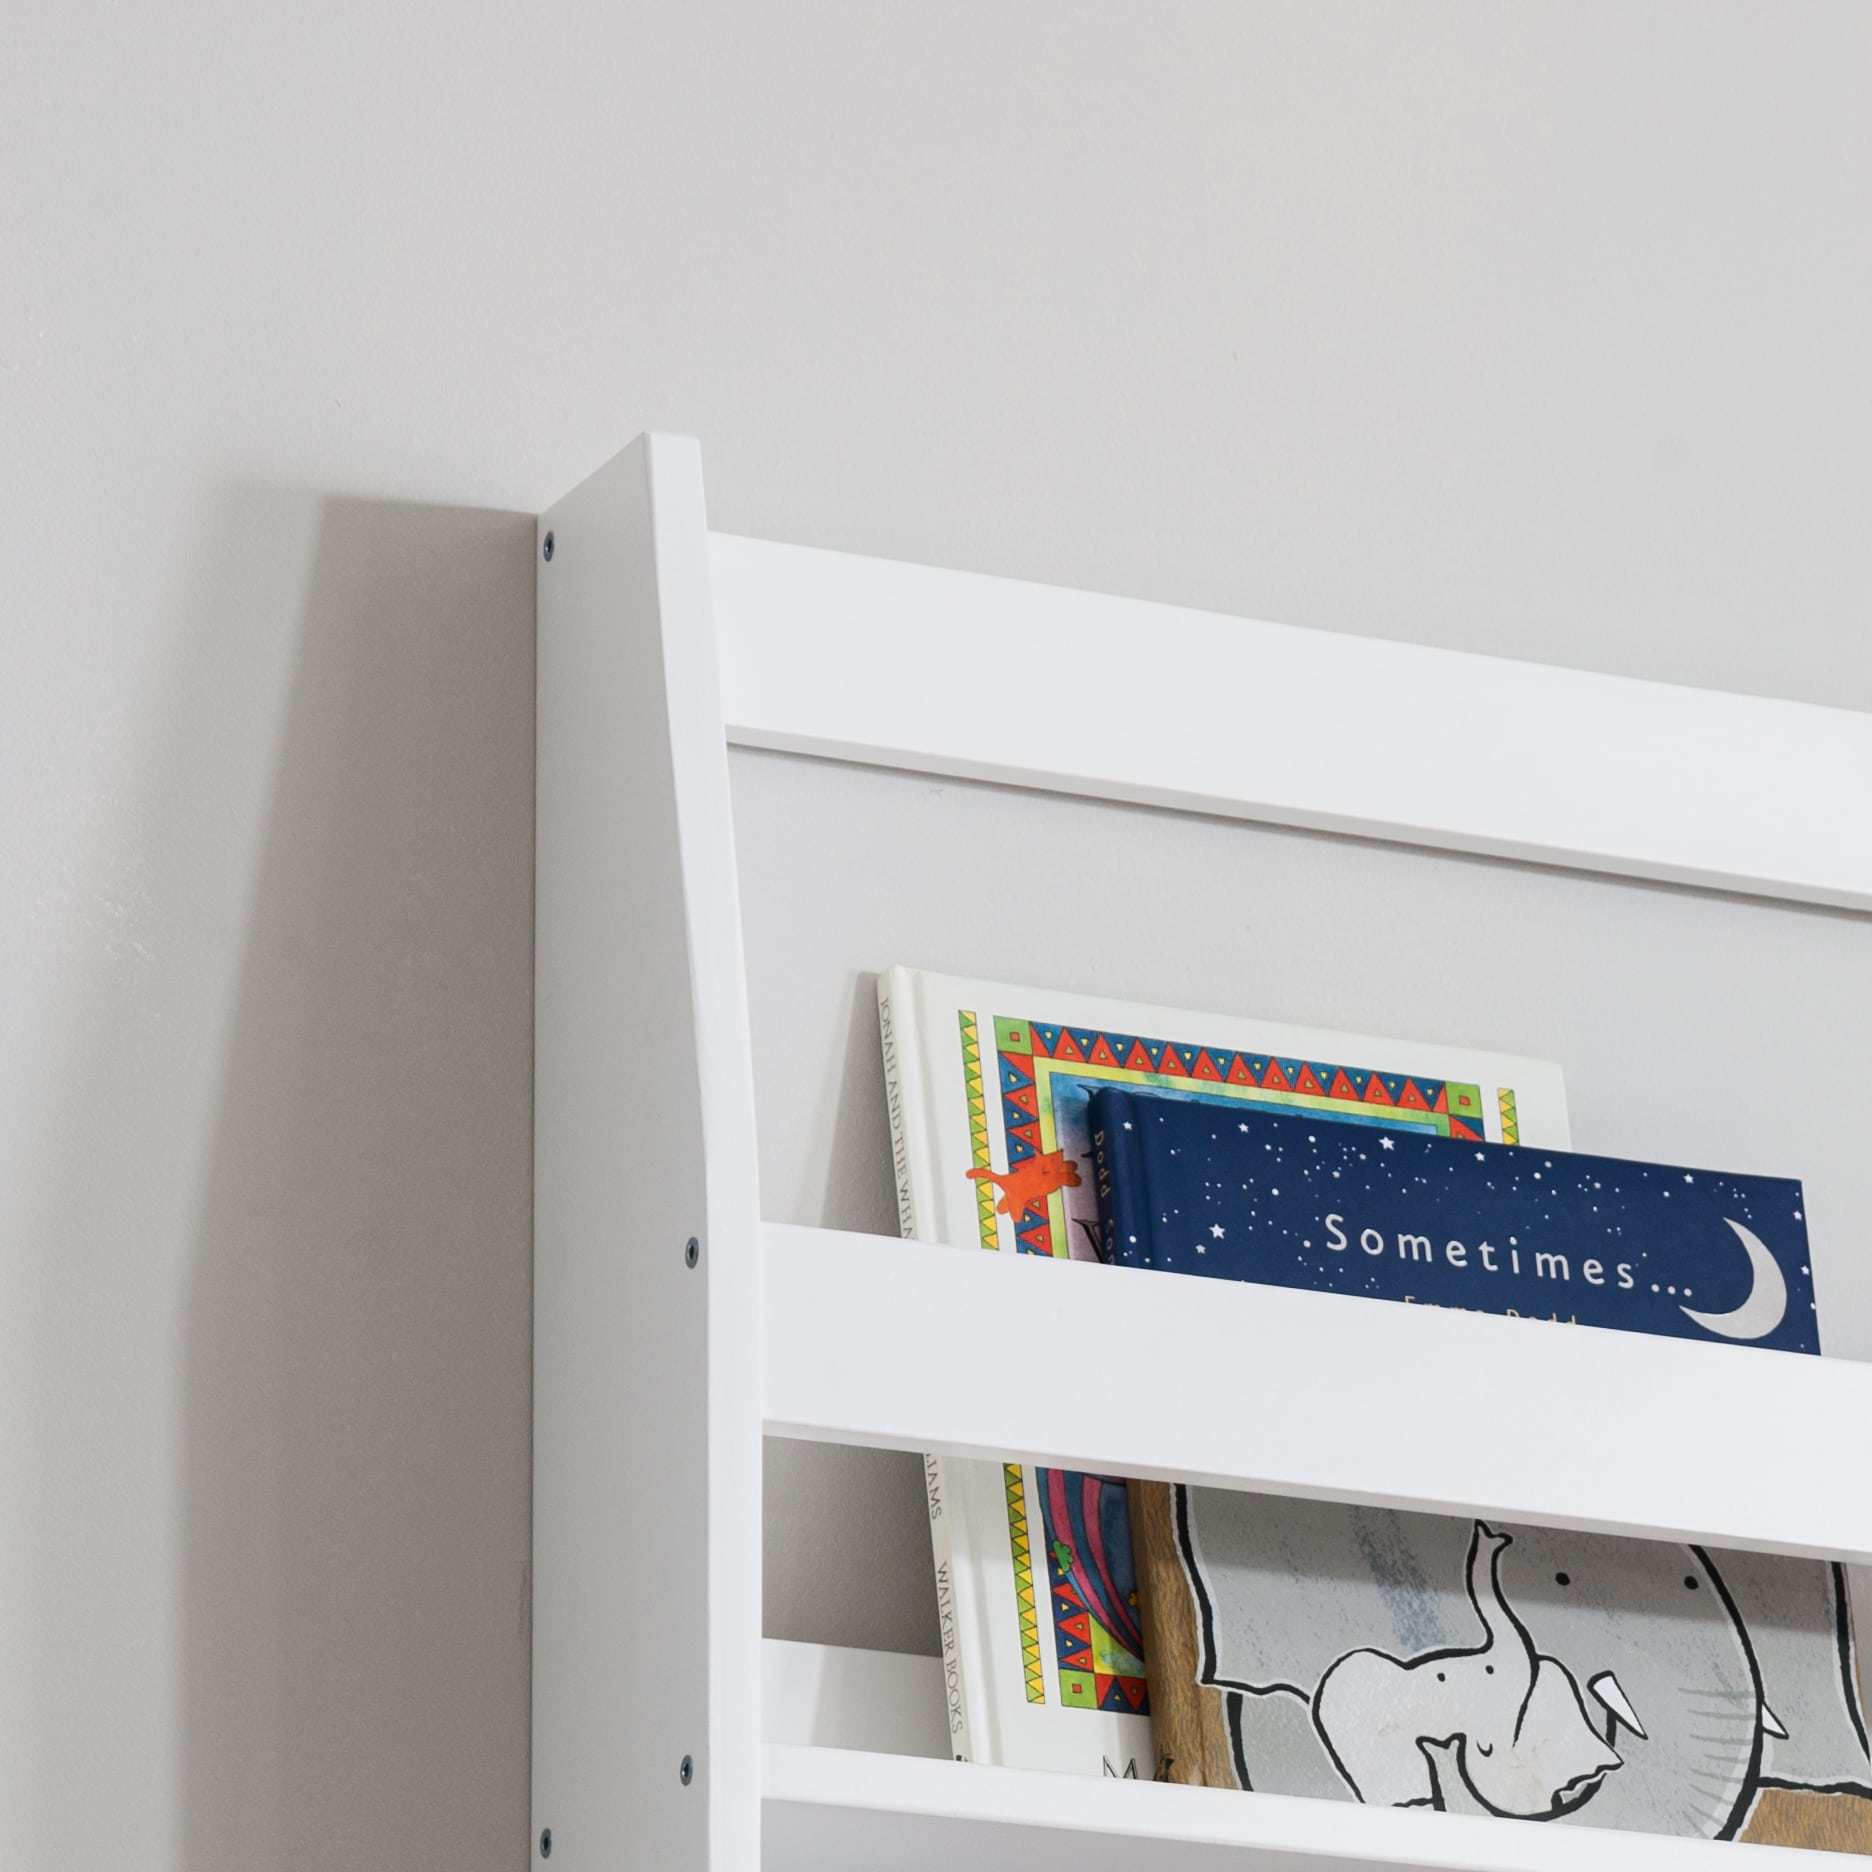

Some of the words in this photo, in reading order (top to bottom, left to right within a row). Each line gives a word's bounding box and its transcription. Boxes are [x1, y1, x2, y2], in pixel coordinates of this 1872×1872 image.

[879, 997, 897, 1077] JONAH
[888, 1080, 902, 1131] AND
[893, 1130, 907, 1180] THE
[1094, 1130, 1111, 1198] Dodd
[1323, 1213, 1693, 1298] Sometimes...
[936, 1561, 955, 1656] WALKER
[946, 1657, 963, 1735] BOOKS
